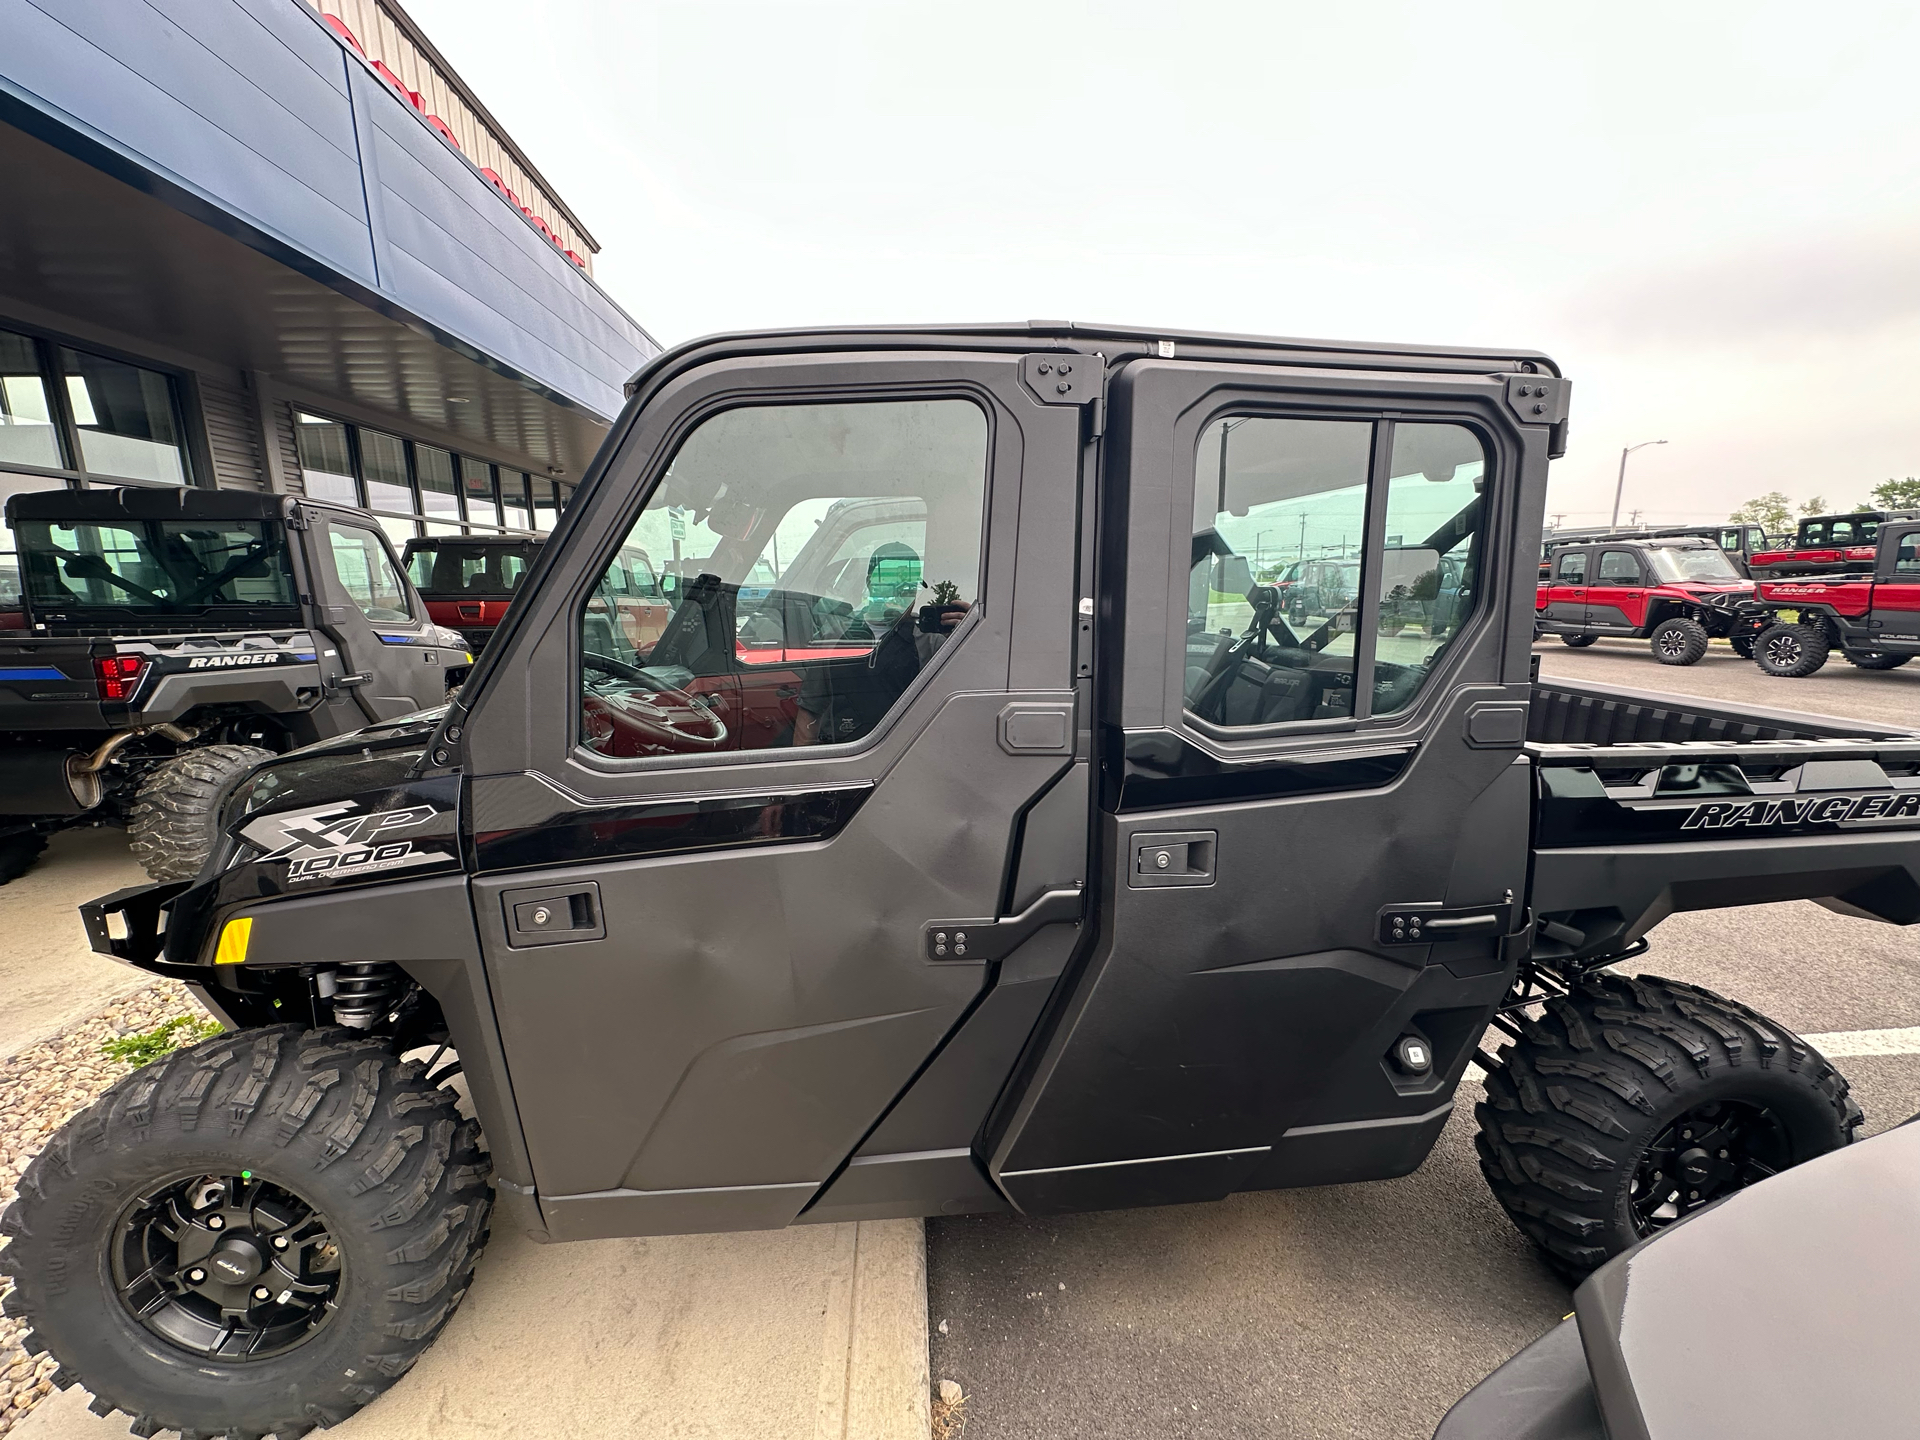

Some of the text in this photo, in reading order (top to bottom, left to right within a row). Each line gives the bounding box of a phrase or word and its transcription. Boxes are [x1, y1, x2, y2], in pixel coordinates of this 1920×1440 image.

[188, 653, 279, 668] RANGER
[1680, 793, 1920, 830] RANGER
[253, 804, 438, 863] XP
[287, 841, 413, 878] 1000
[288, 859, 405, 884] DUAL OVERHEAD CAM
